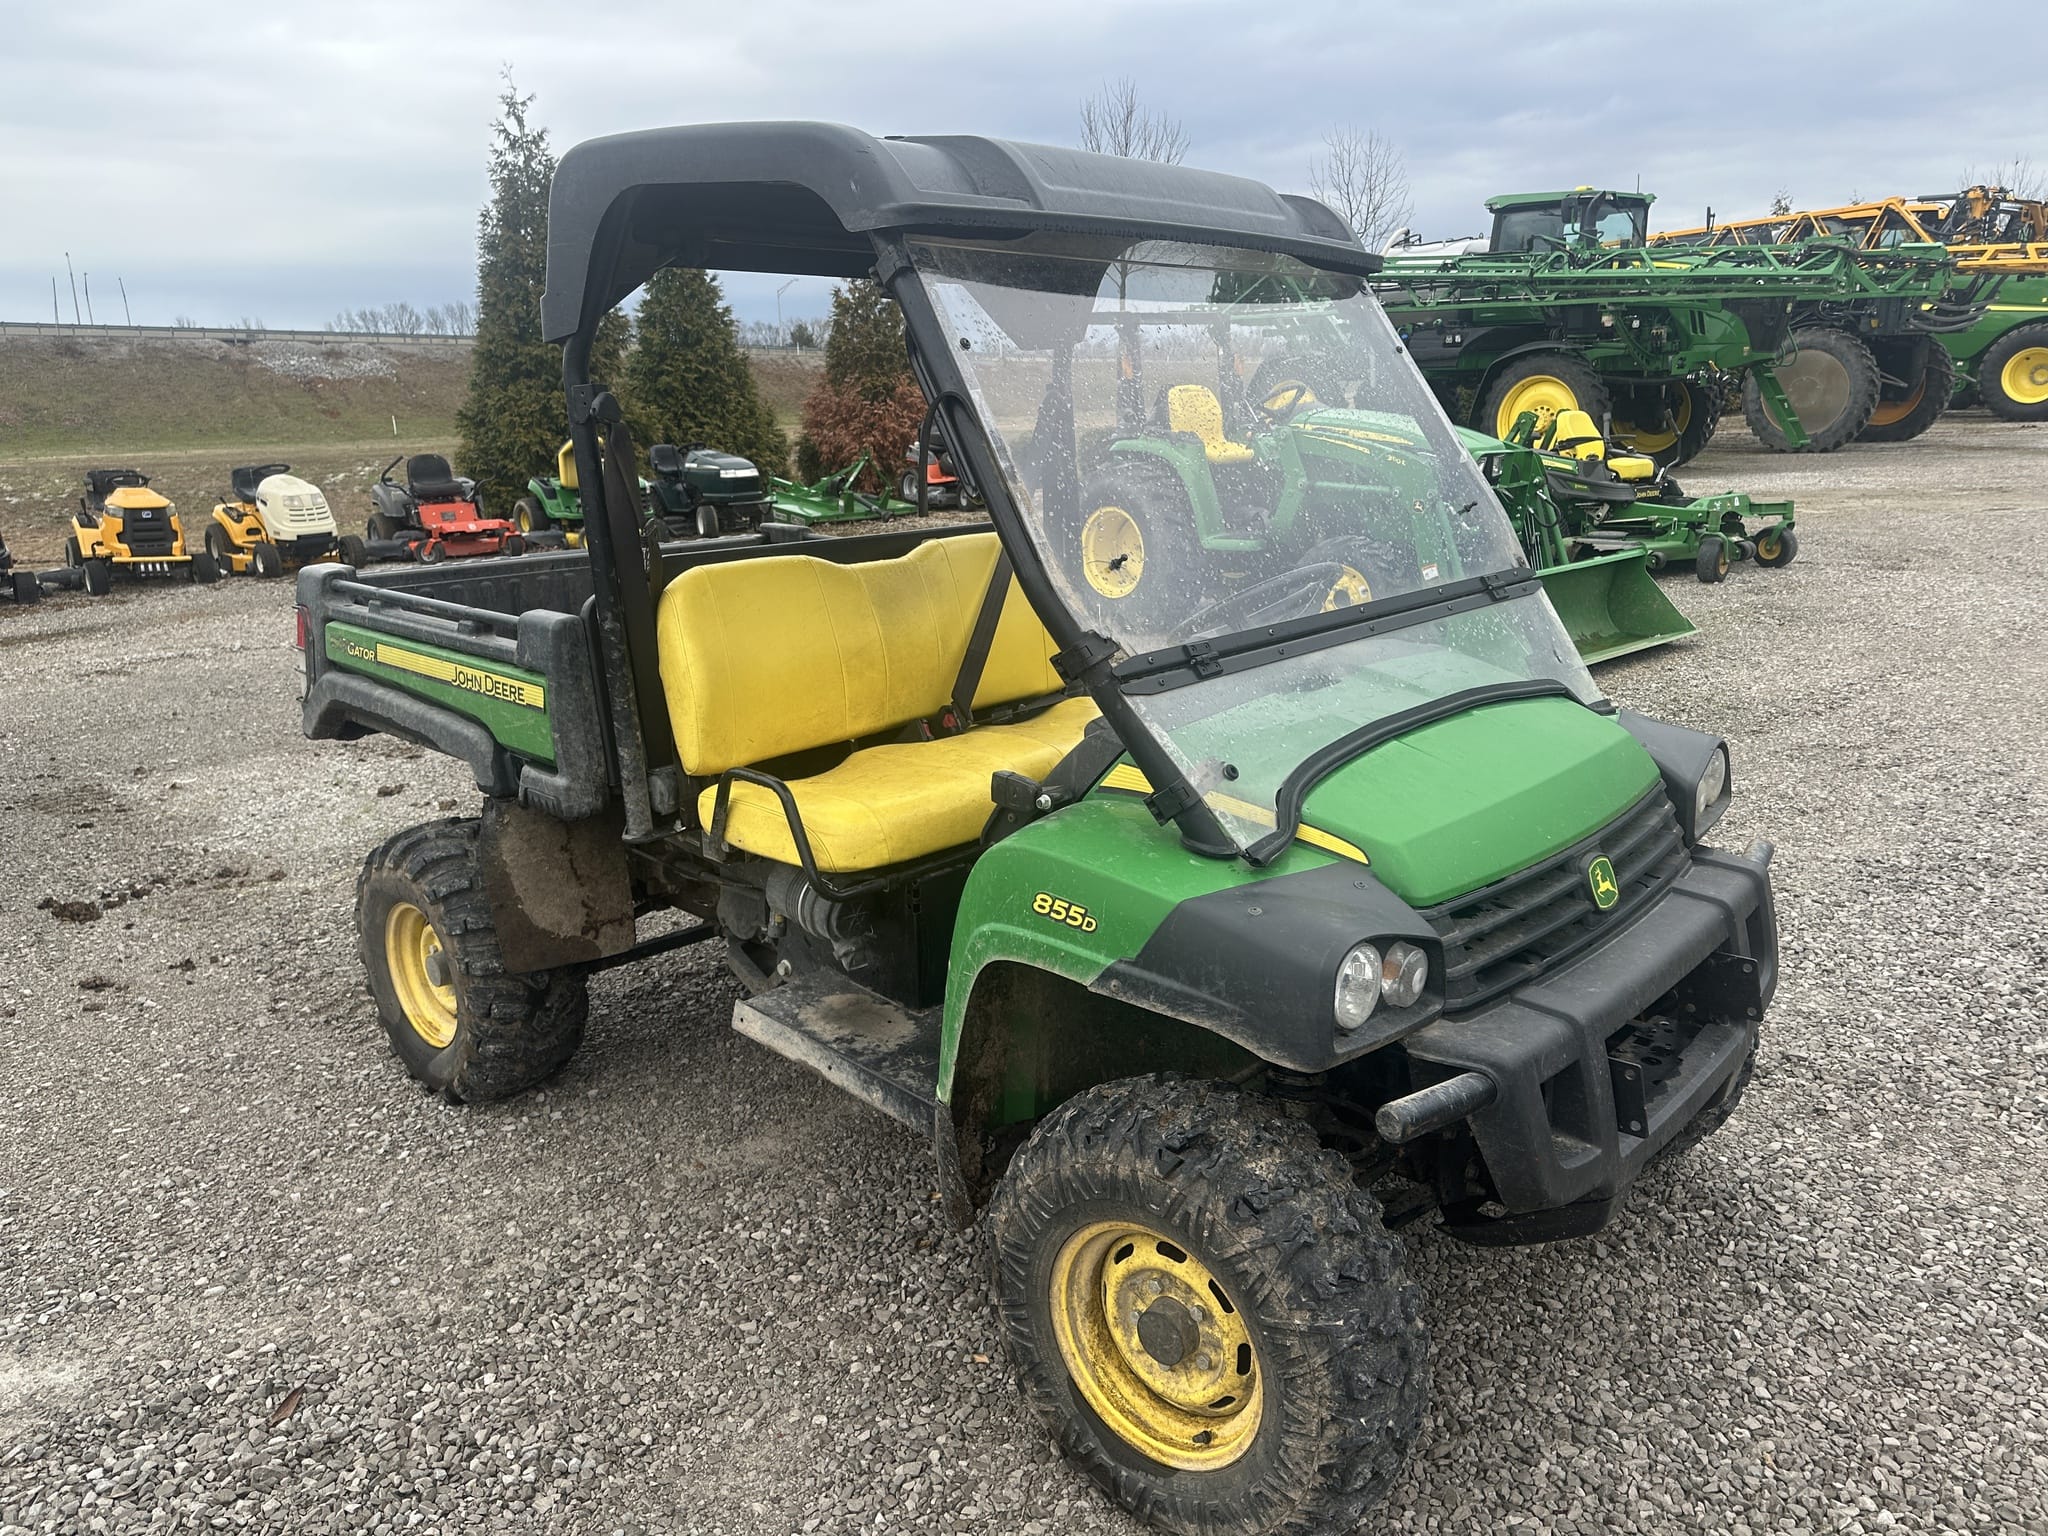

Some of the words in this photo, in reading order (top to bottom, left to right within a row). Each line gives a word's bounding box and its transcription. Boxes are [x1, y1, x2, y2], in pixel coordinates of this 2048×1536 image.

[347, 642, 375, 662] GATOR
[451, 666, 482, 691] JOHN
[484, 674, 525, 703] DEERE
[1032, 892, 1097, 932] 855D
